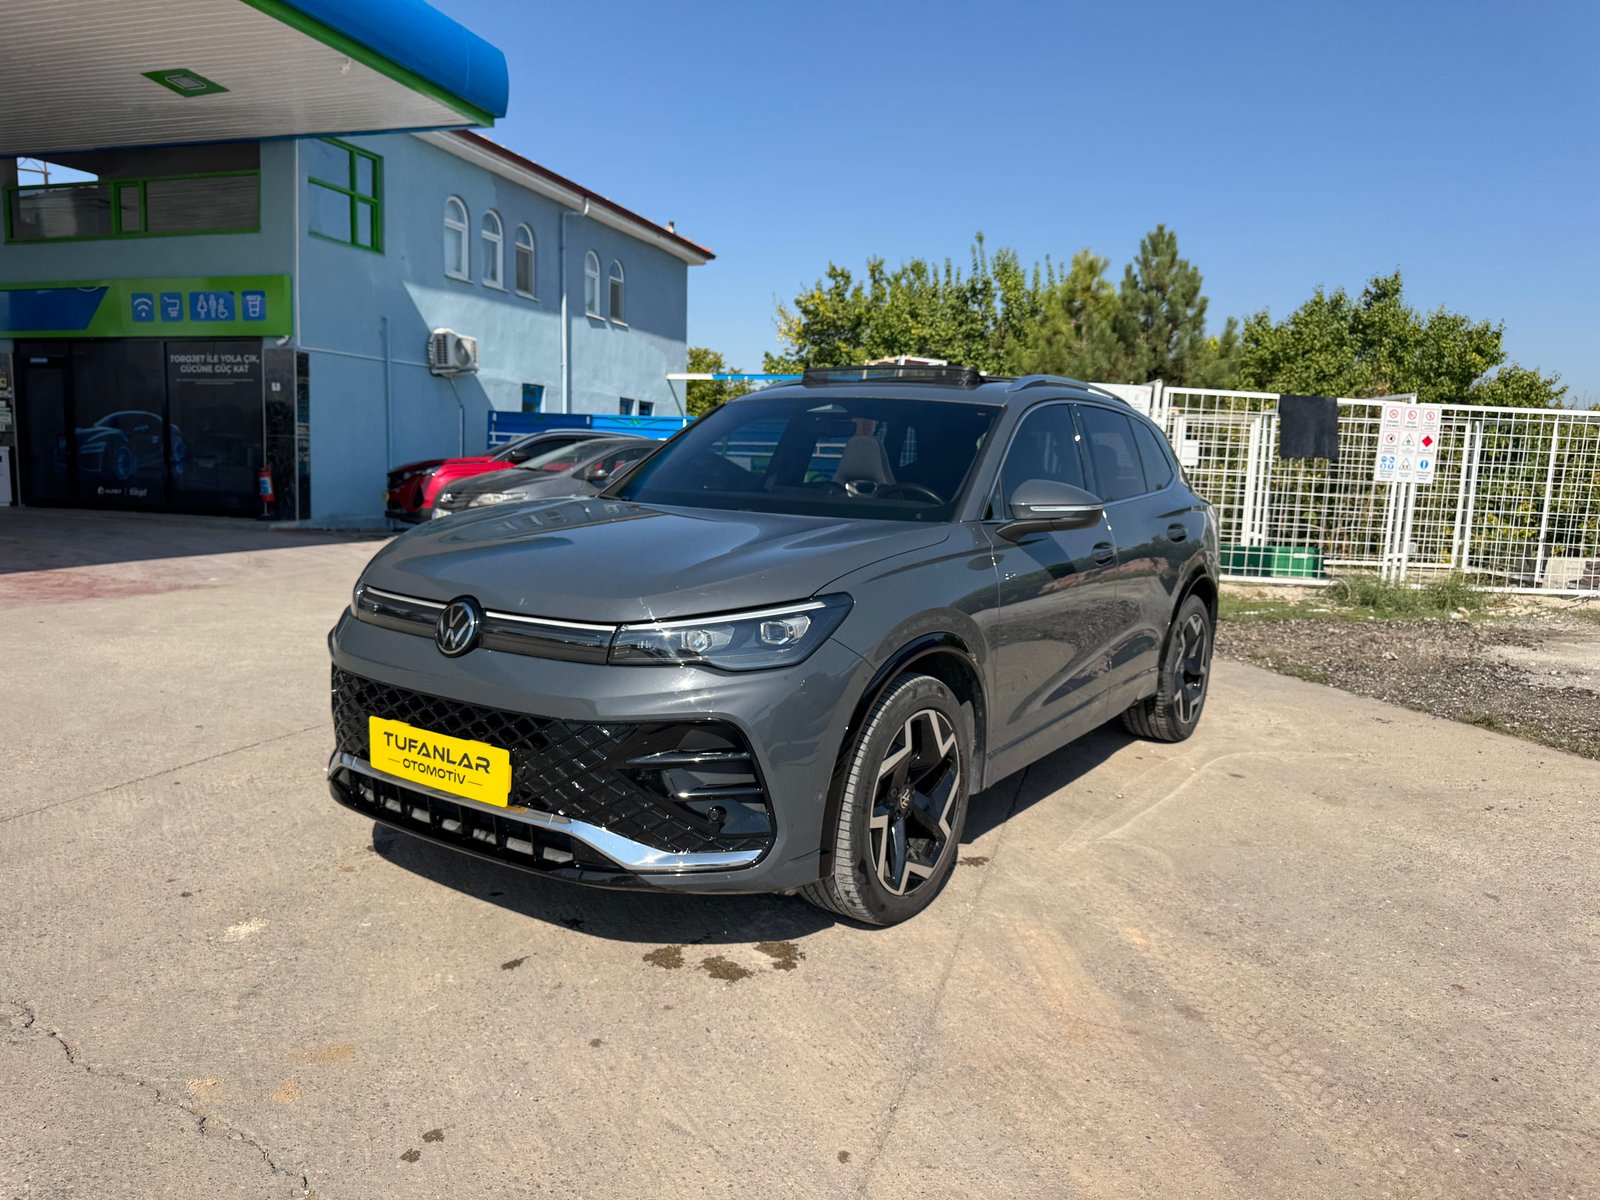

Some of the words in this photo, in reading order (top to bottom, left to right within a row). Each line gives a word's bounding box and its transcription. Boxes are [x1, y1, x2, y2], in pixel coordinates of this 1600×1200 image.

[219, 354, 242, 363] YOLA
[233, 364, 250, 373] KAT
[383, 731, 491, 774] TUFANLAR
[402, 758, 466, 785] OTOMOTİV
